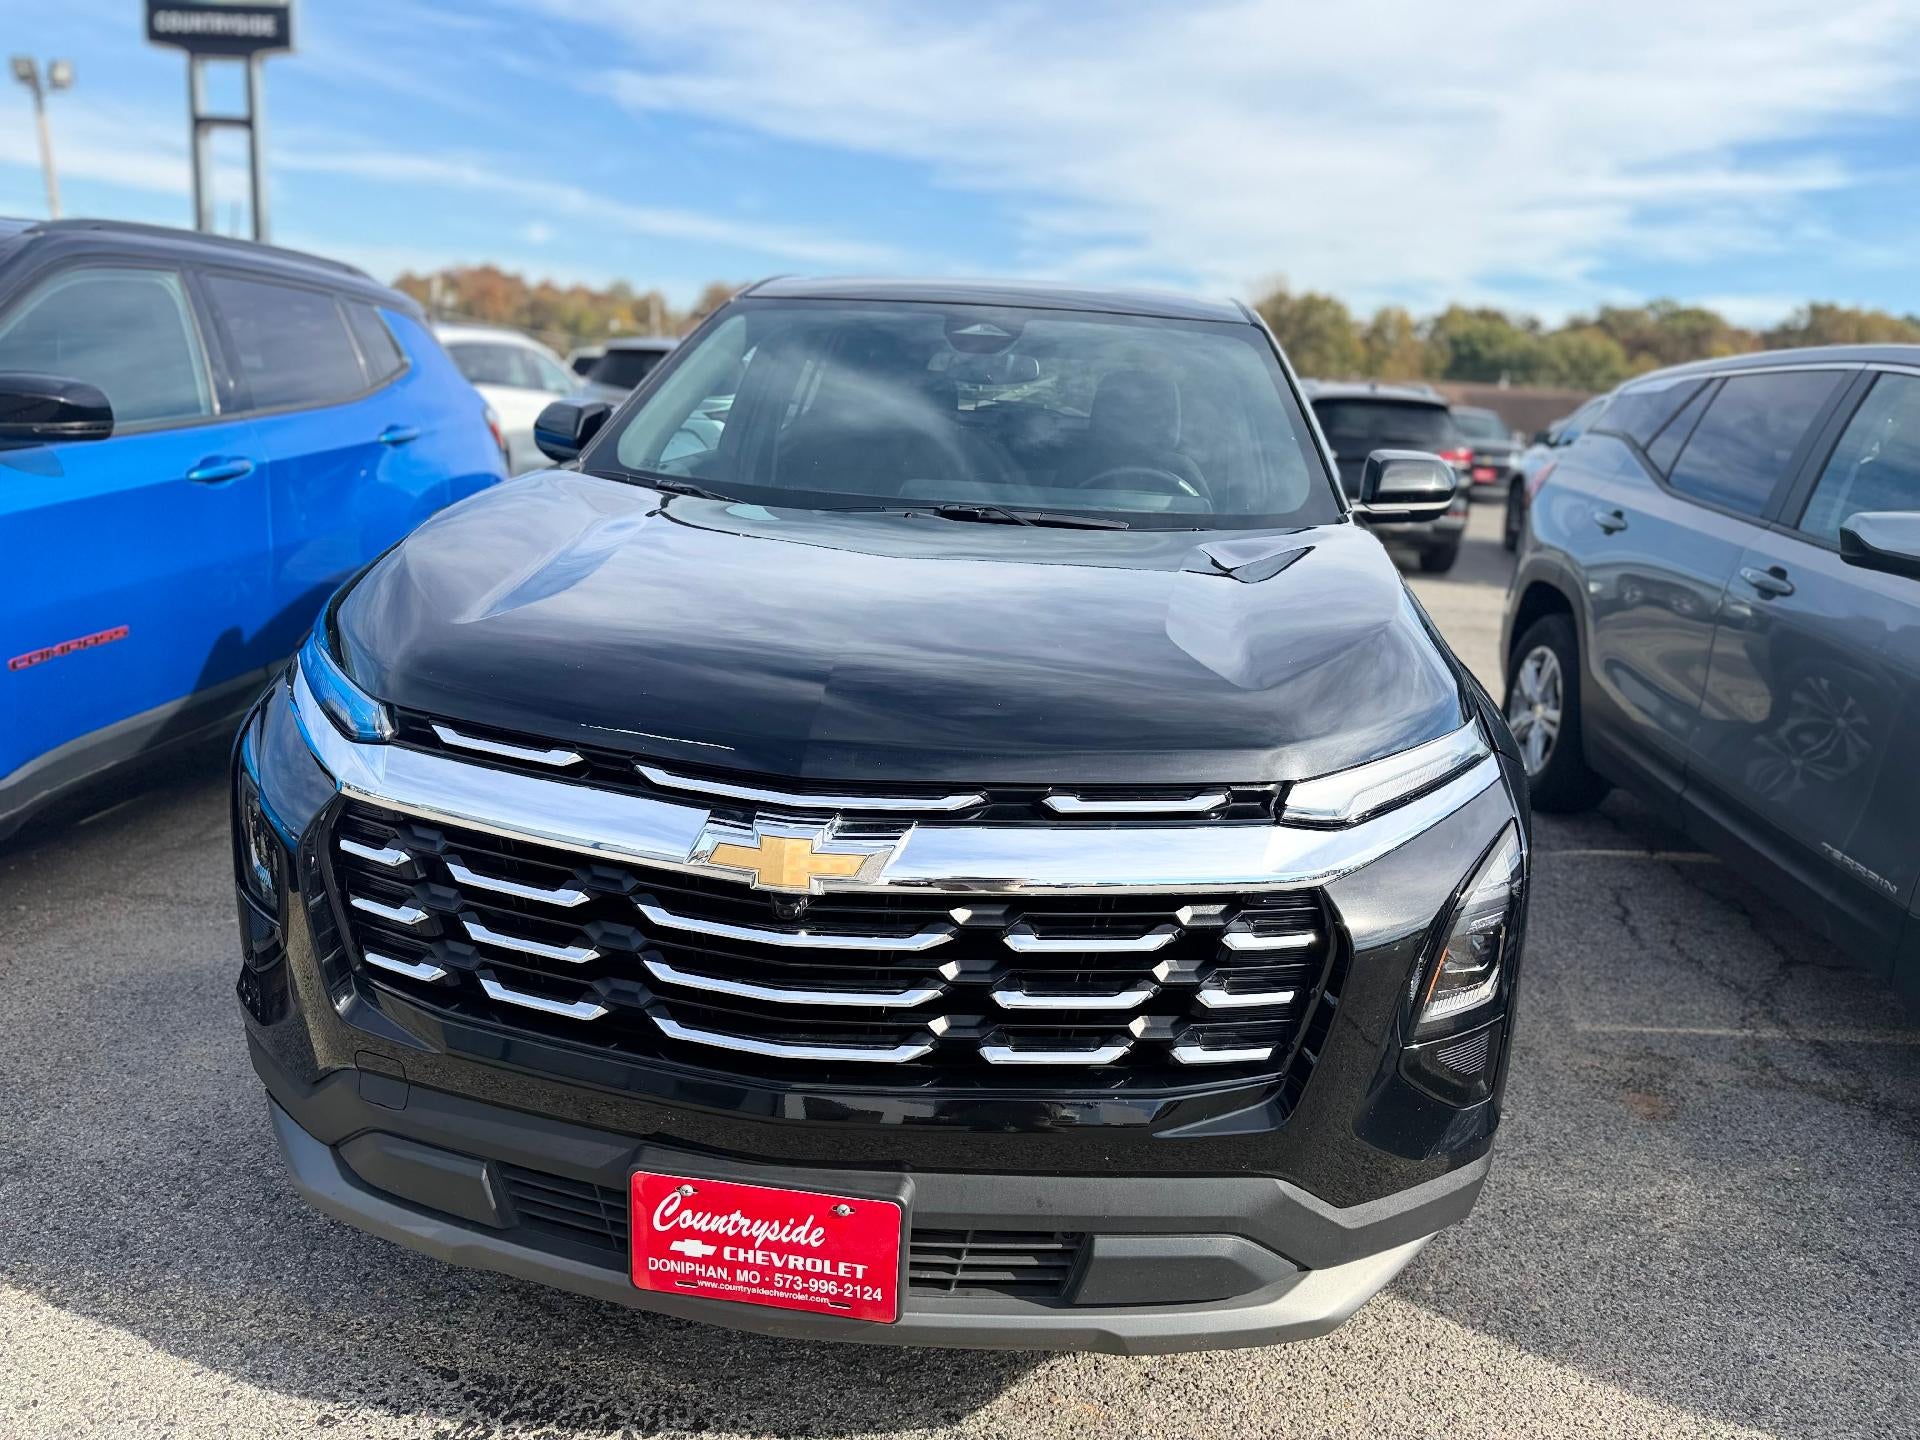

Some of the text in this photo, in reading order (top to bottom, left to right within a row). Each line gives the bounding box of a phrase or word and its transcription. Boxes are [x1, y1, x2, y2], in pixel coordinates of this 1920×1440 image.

[153, 10, 278, 37] COUNTRYSIDE
[8, 624, 129, 672] COMPASS
[653, 1191, 825, 1247] Countryside
[648, 1257, 882, 1301] DONIPHAN, MO 573-996-2124
[723, 1245, 868, 1279] CHEVROLET
[697, 1279, 829, 1304] www.countrysidechevrolet.com
